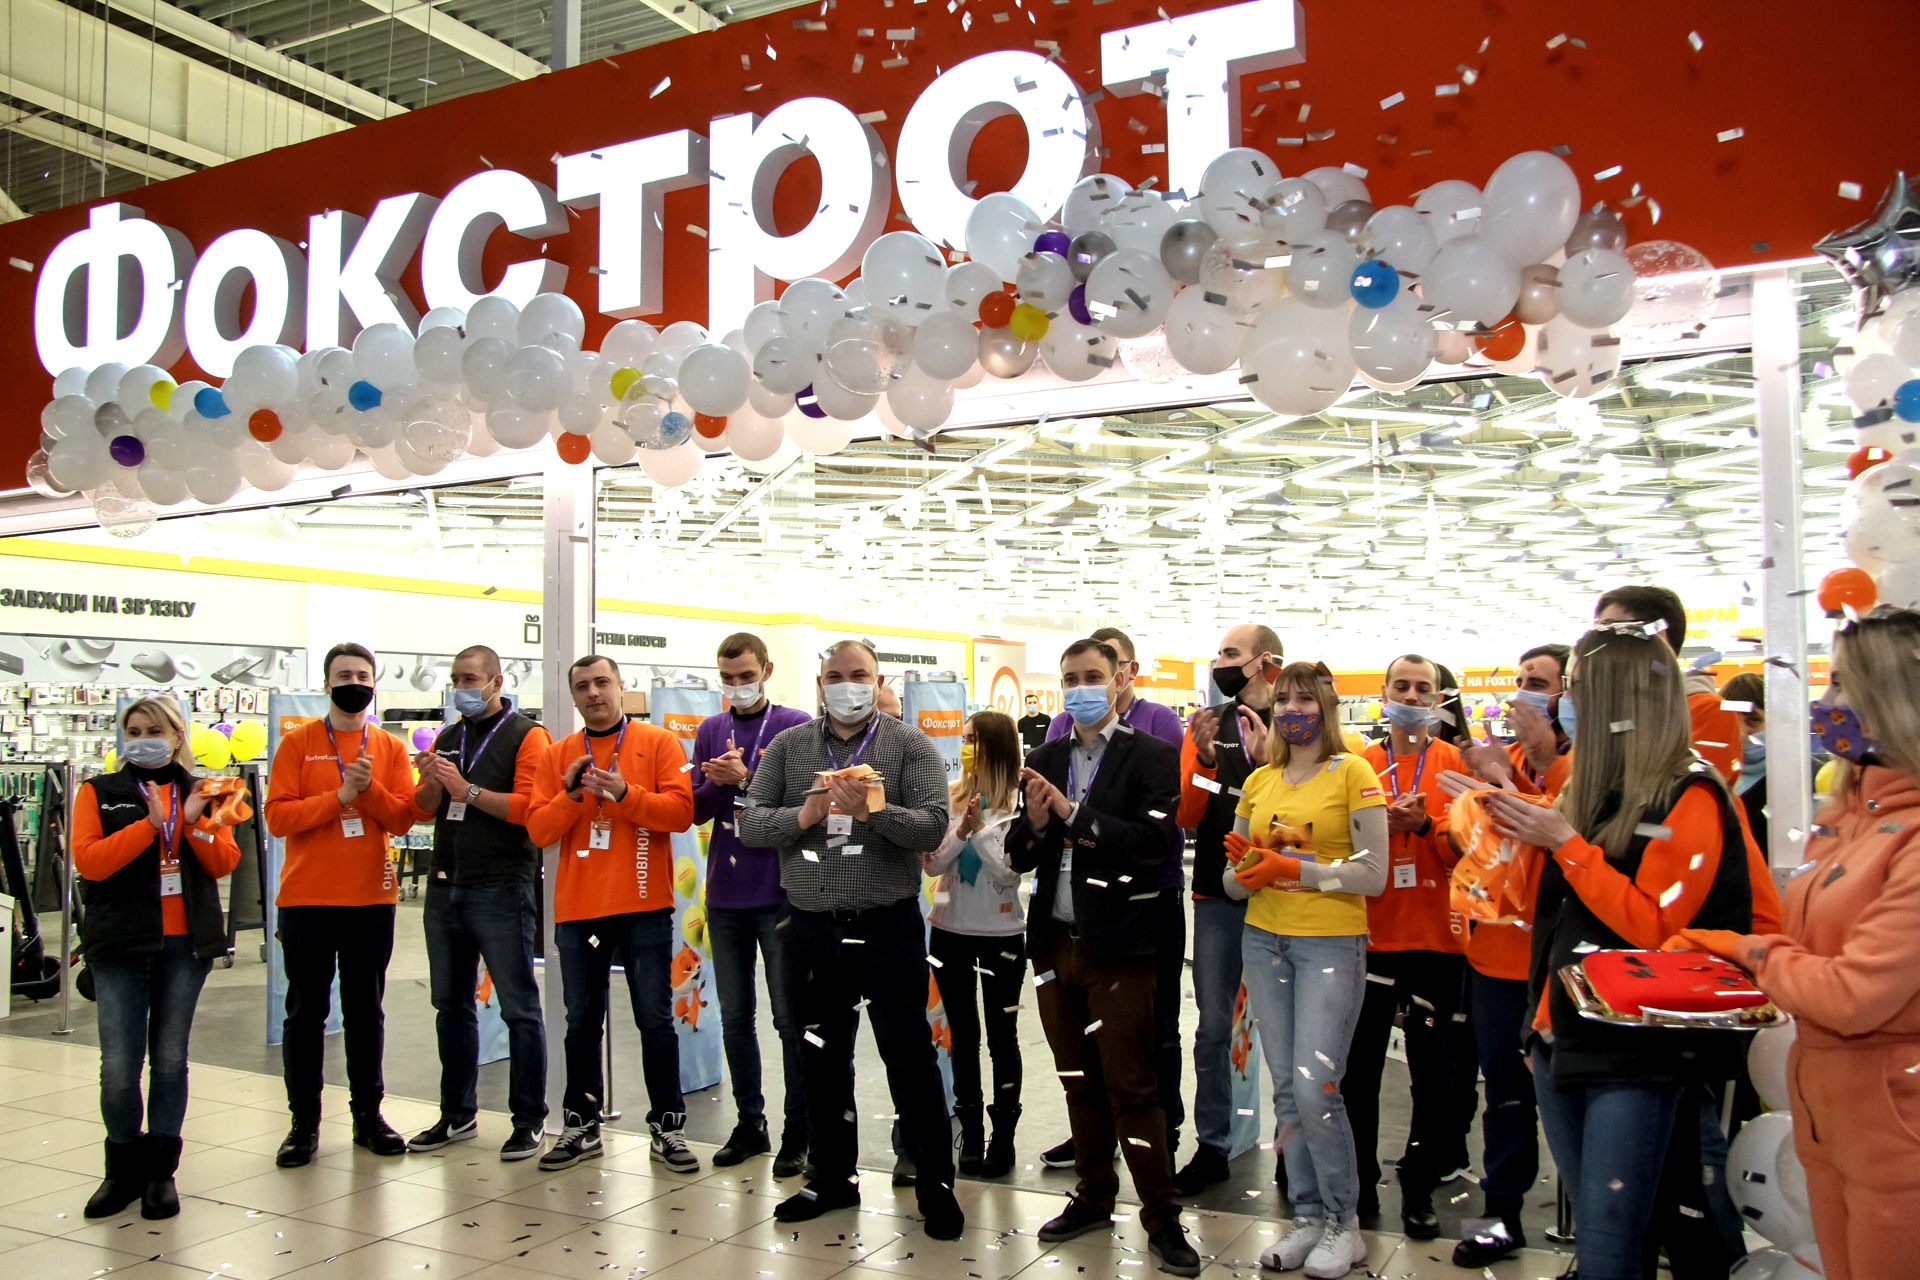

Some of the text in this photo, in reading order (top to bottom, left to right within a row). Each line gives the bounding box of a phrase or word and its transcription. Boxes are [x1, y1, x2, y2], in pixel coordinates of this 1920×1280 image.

[1, 588, 197, 618] ЗАВЖДИ НА ЗВ'ЯЗКУ
[628, 634, 667, 648] БОНУСІВ
